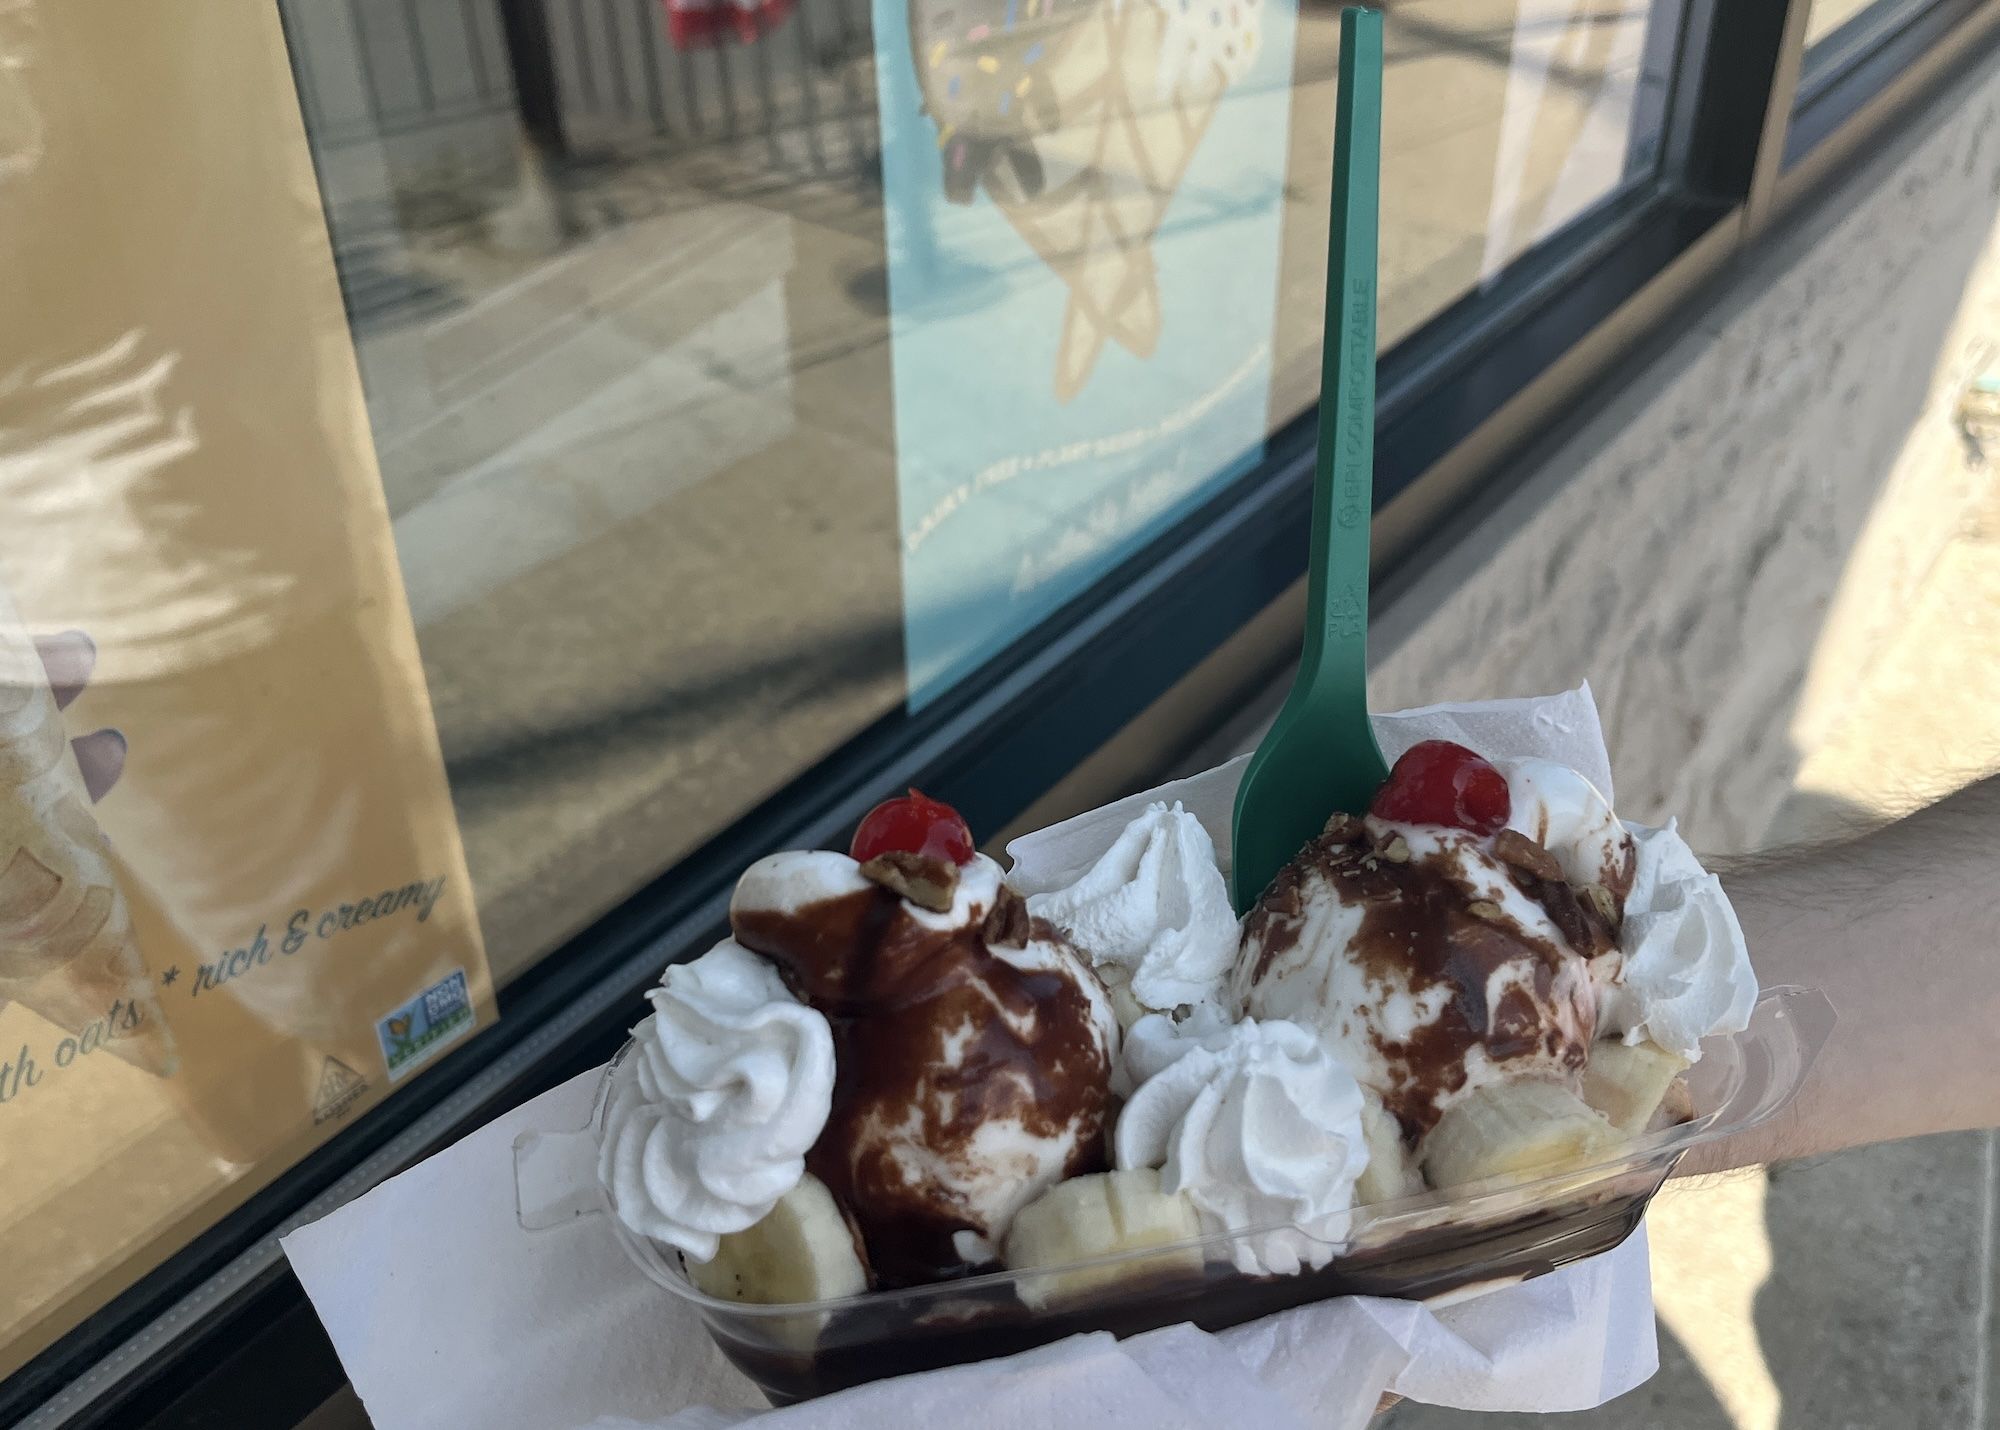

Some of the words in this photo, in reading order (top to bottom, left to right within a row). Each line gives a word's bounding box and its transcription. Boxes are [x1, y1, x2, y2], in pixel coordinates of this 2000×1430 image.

[192, 923, 272, 997] rich
[281, 908, 309, 954] &
[316, 874, 446, 939] creamy
[55, 999, 139, 1067] oats
